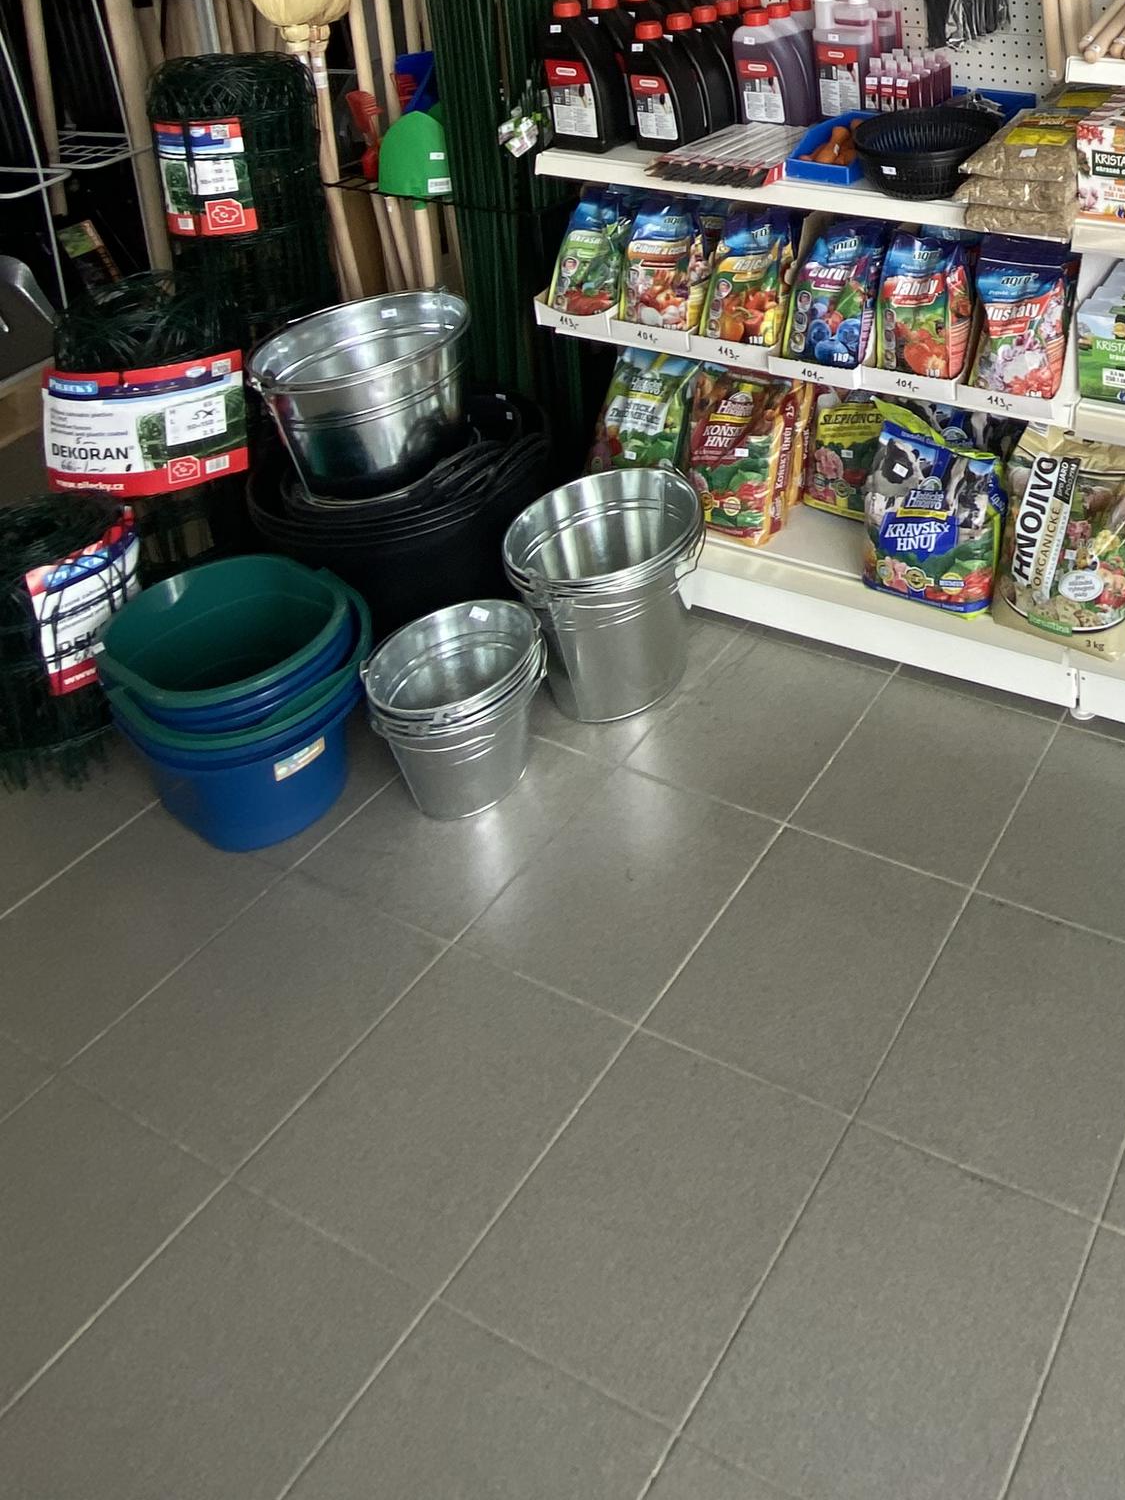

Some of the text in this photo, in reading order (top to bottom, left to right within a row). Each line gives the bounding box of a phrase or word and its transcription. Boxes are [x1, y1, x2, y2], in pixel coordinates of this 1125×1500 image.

[1001, 274, 1031, 287] agro
[51, 442, 129, 461] DEKORAN
[1013, 456, 1058, 581] HNOJIVO
[884, 521, 951, 539] KRAVSKÝ
[1085, 639, 1105, 651] 3 kg
